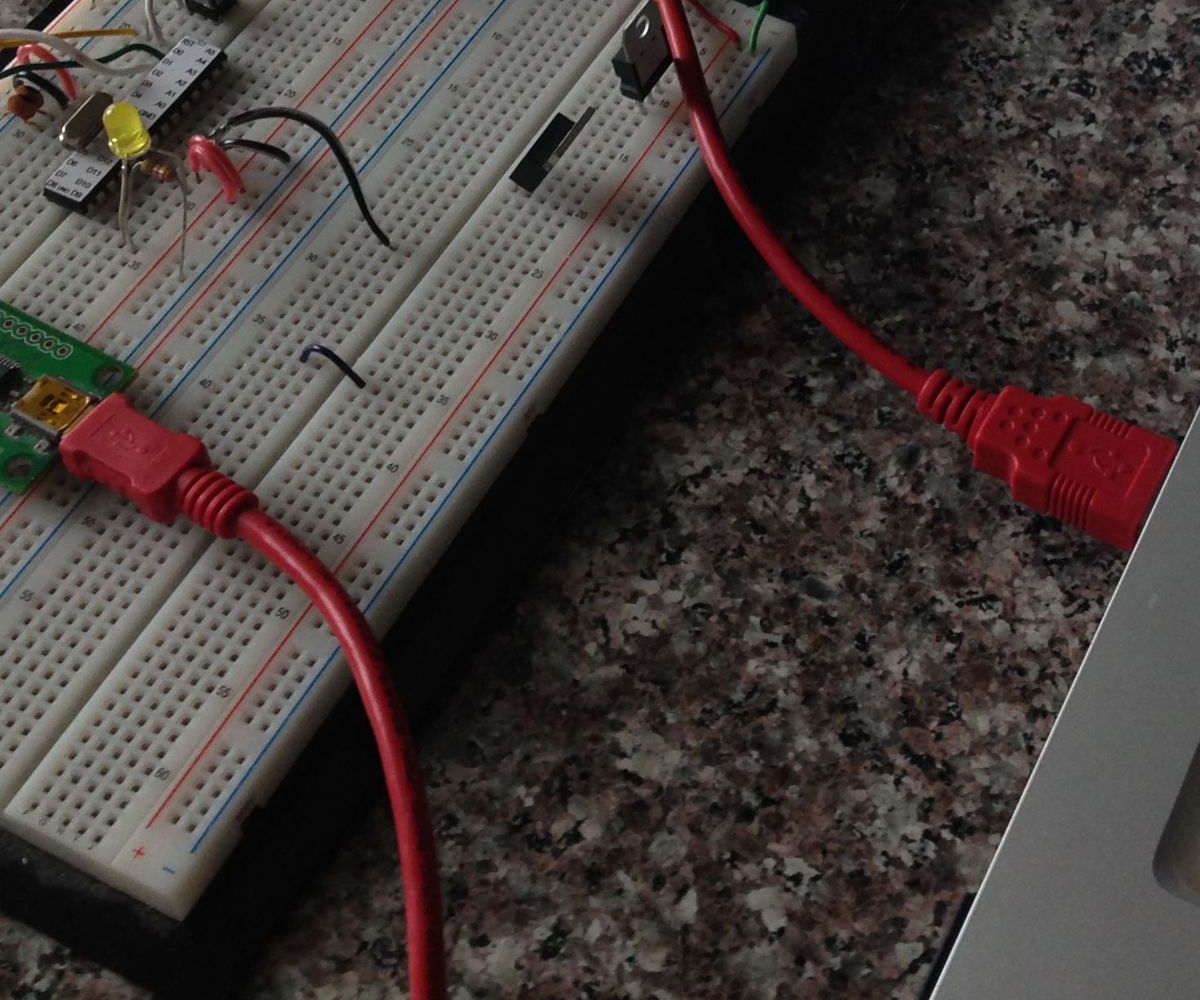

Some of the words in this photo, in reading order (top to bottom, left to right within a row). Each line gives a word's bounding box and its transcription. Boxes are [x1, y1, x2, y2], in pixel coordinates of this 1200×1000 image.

[275, 608, 289, 620] 50
[216, 686, 231, 698] 55
[155, 768, 170, 781] 60
